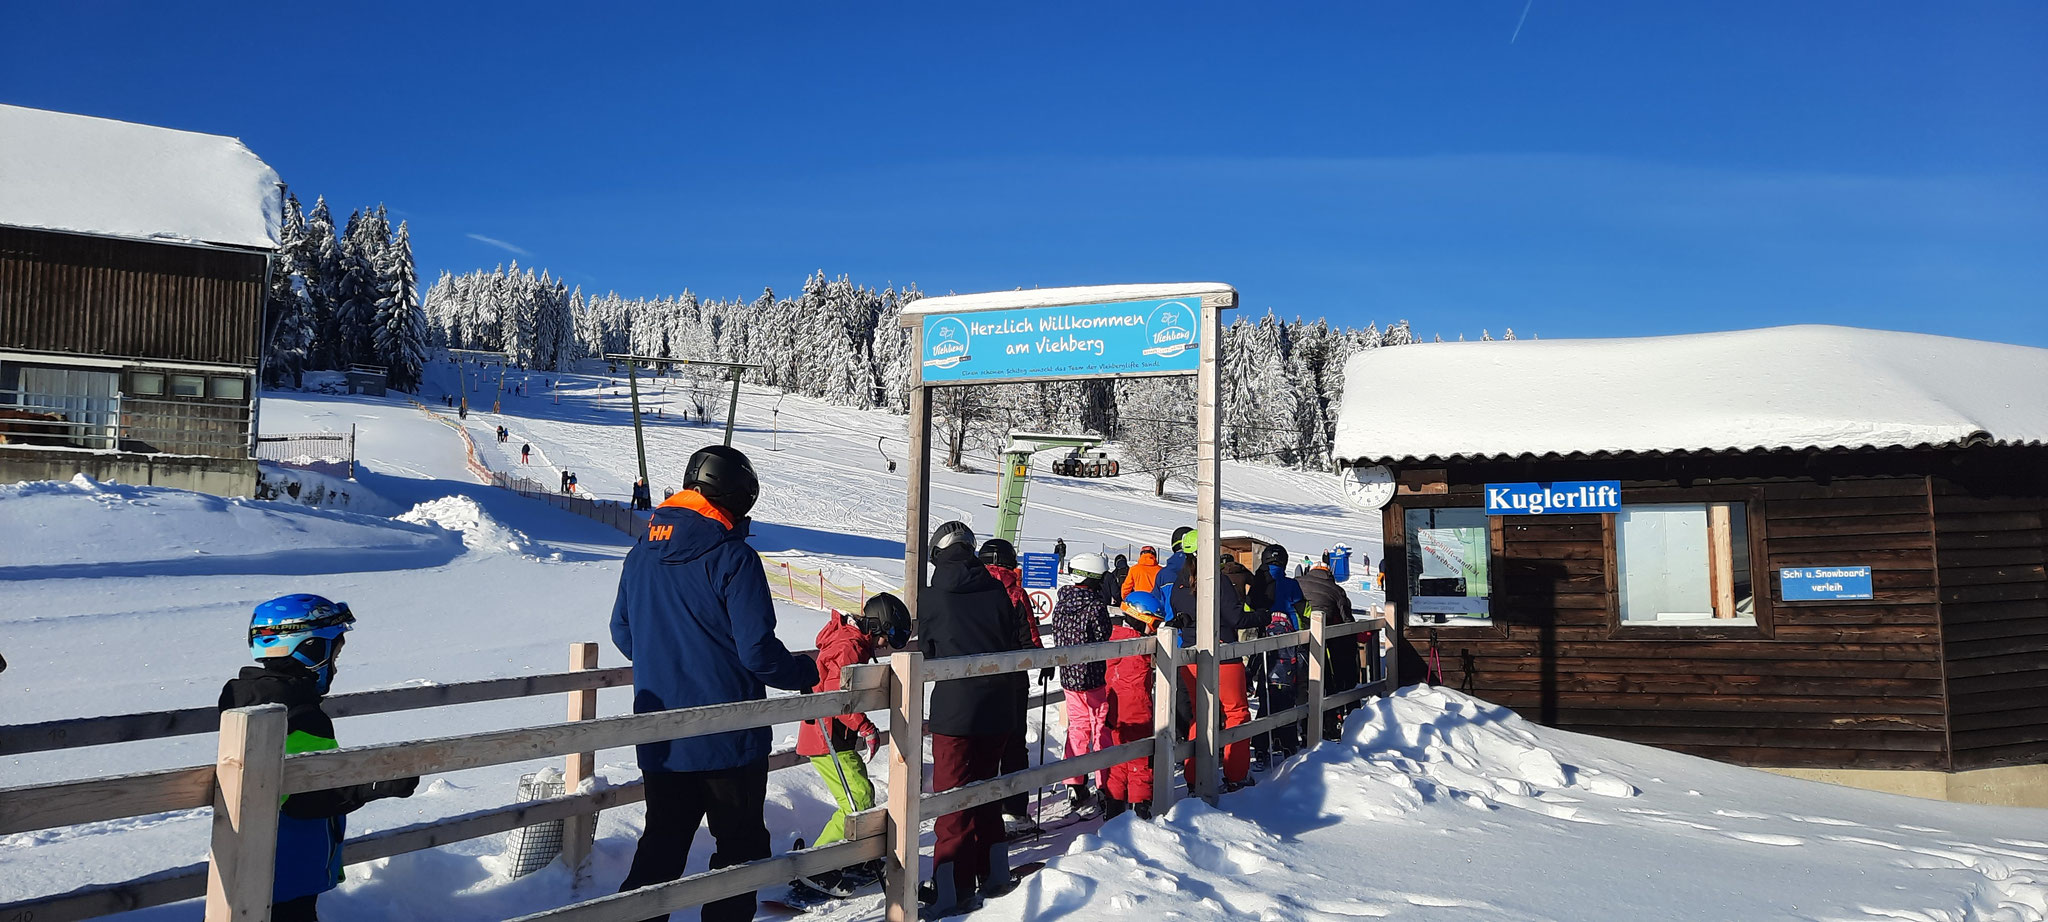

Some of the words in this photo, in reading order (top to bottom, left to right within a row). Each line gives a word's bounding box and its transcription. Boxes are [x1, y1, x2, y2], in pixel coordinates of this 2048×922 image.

[970, 317, 1034, 336] Herzlich
[1039, 313, 1145, 333] Willkommen
[1153, 330, 1190, 344] Viehberg
[932, 343, 964, 356] Viehberg
[1005, 344, 1030, 355] am
[1035, 334, 1104, 356] Viehberg
[1086, 363, 1098, 371] der
[1488, 485, 1618, 514] Kuglerlift
[649, 525, 674, 541] HH
[1436, 554, 1460, 575] webcam
[1783, 570, 1802, 578] Schi
[1811, 583, 1843, 592] verleih
